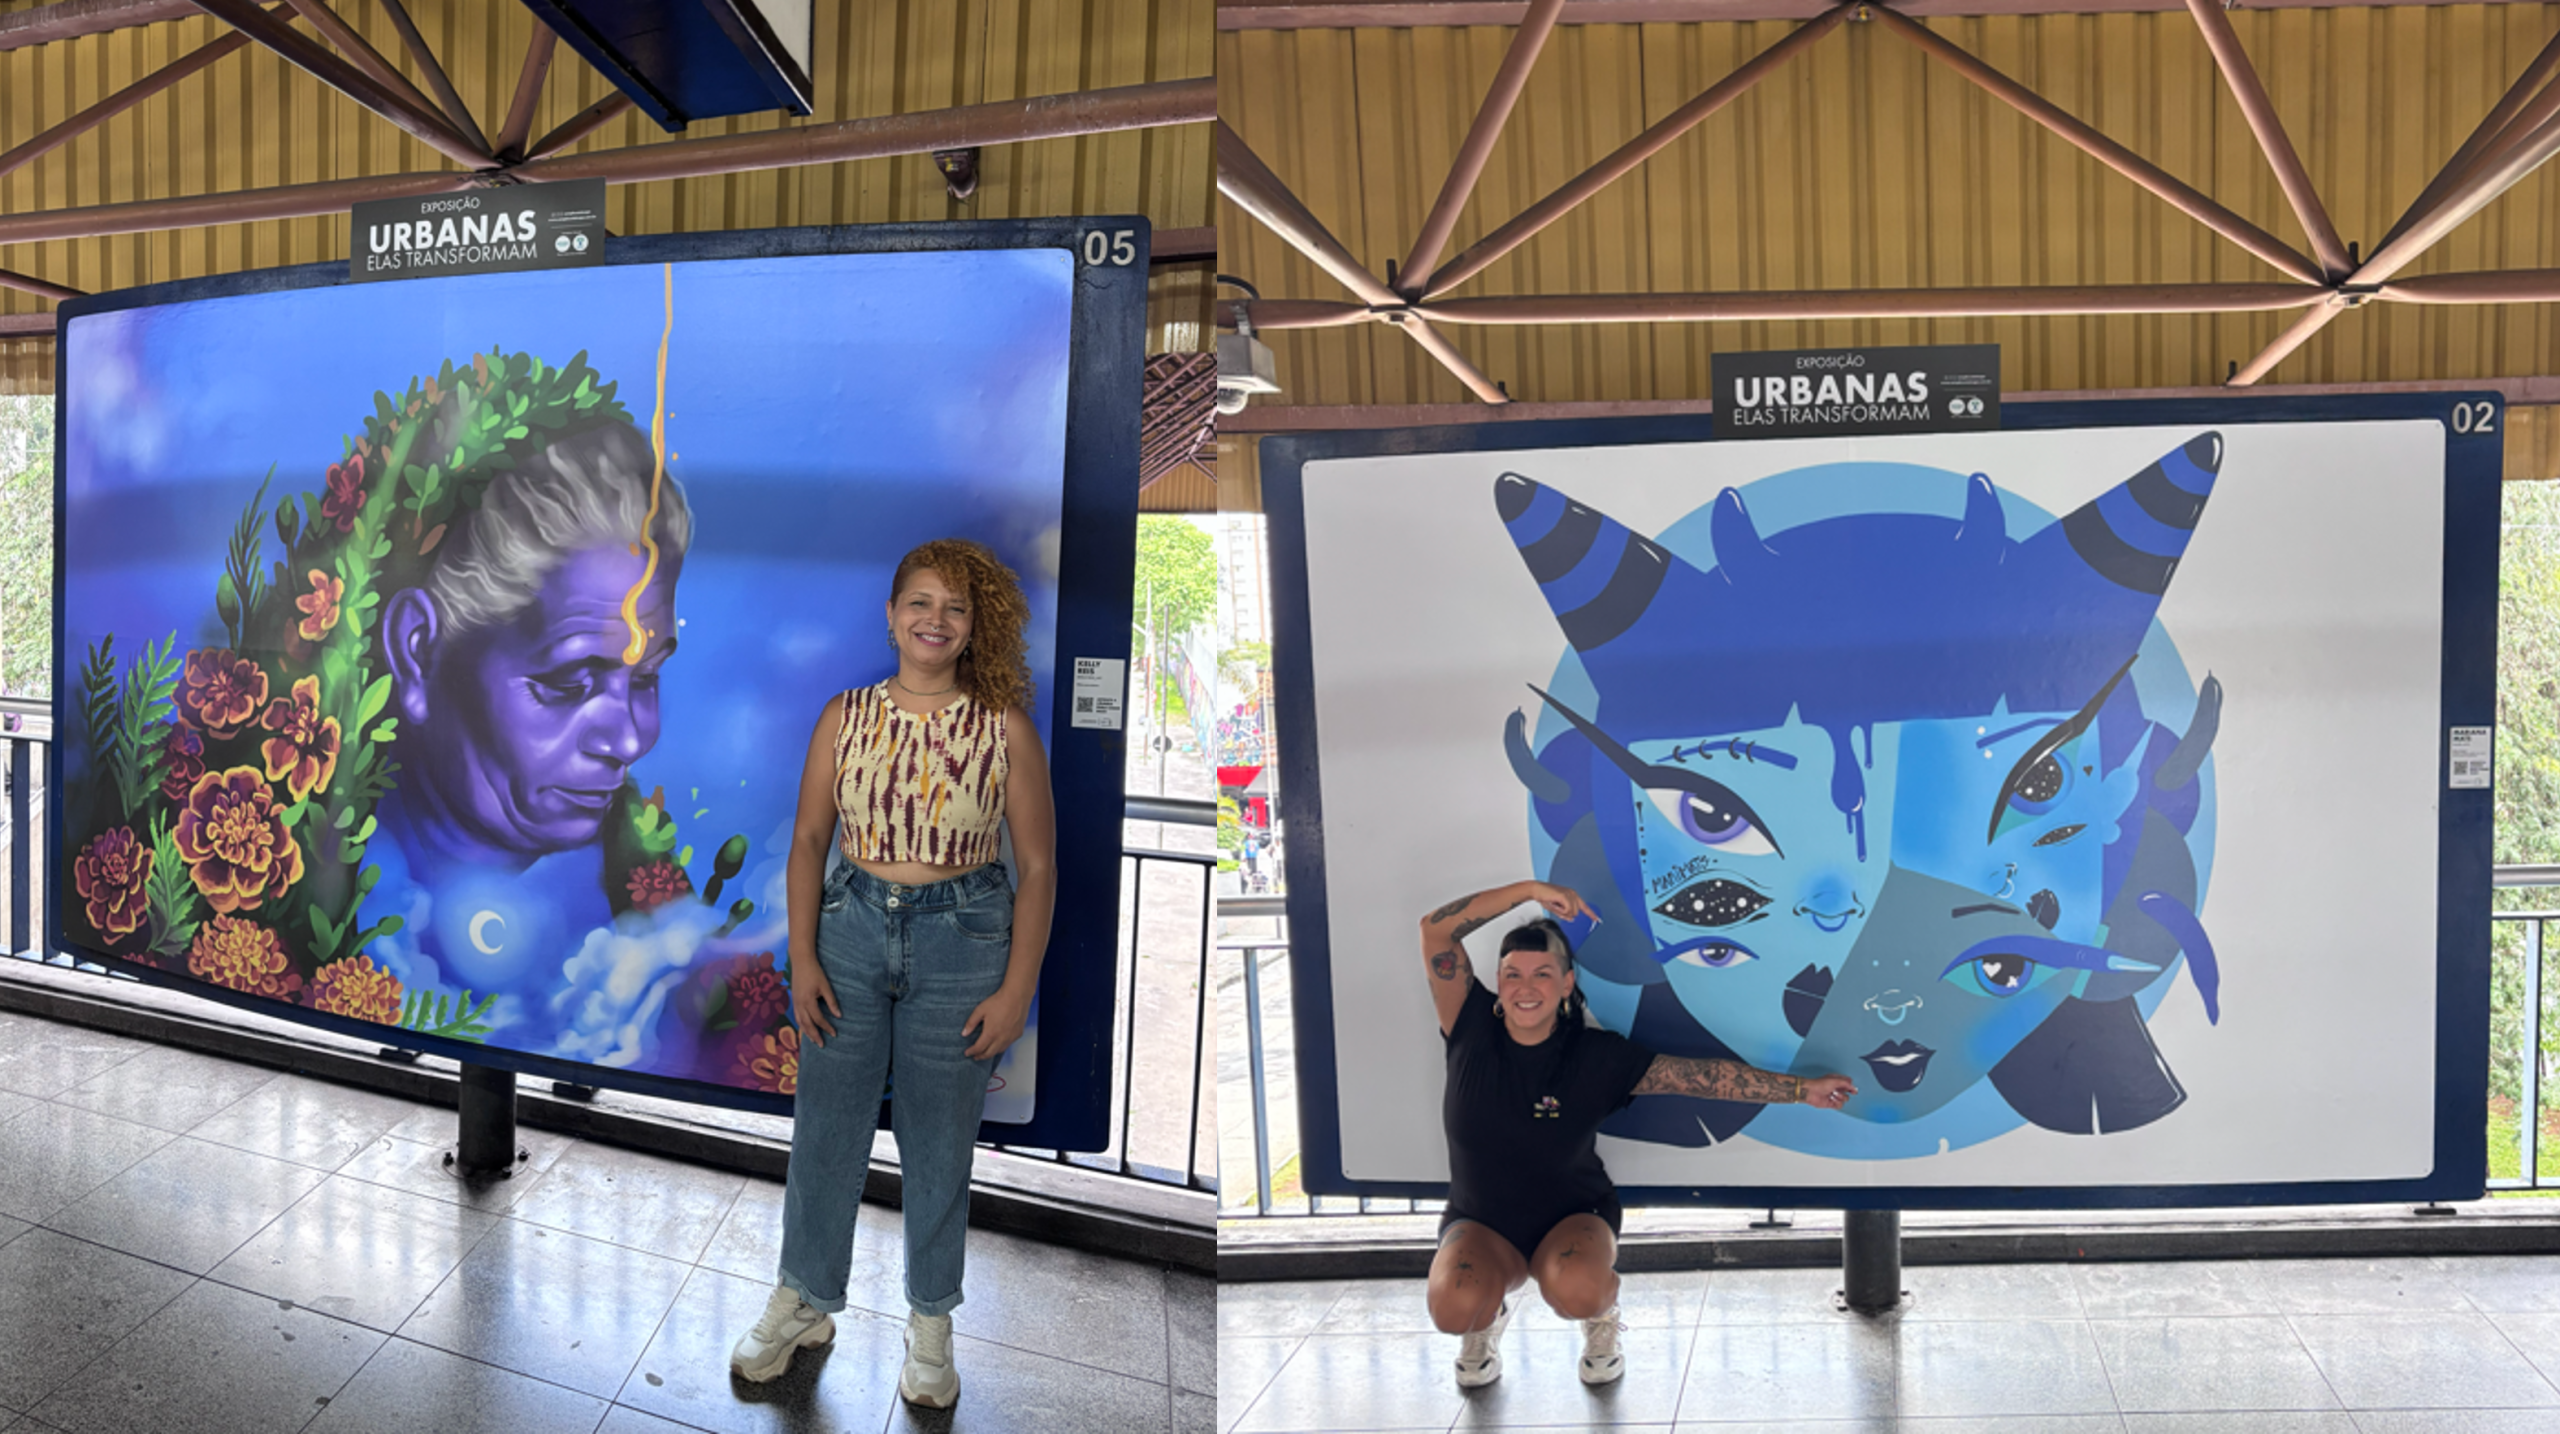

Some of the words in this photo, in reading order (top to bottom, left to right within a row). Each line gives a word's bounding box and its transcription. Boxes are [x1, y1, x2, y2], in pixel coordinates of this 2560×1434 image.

[421, 197, 480, 214] EXPOSIÇÃO
[369, 210, 537, 253] URBANAS
[366, 254, 401, 271] ELAS
[405, 243, 538, 268] TRANSFORMAM
[1084, 229, 1135, 266] 05
[1796, 353, 1865, 370] EXPOSIÇÃO
[1734, 371, 1929, 408] URBANAS
[1733, 408, 1776, 426] ELAS
[1780, 404, 1931, 424] TRANSFORMAM
[2452, 401, 2495, 434] 02
[1077, 660, 1101, 668] KELLY
